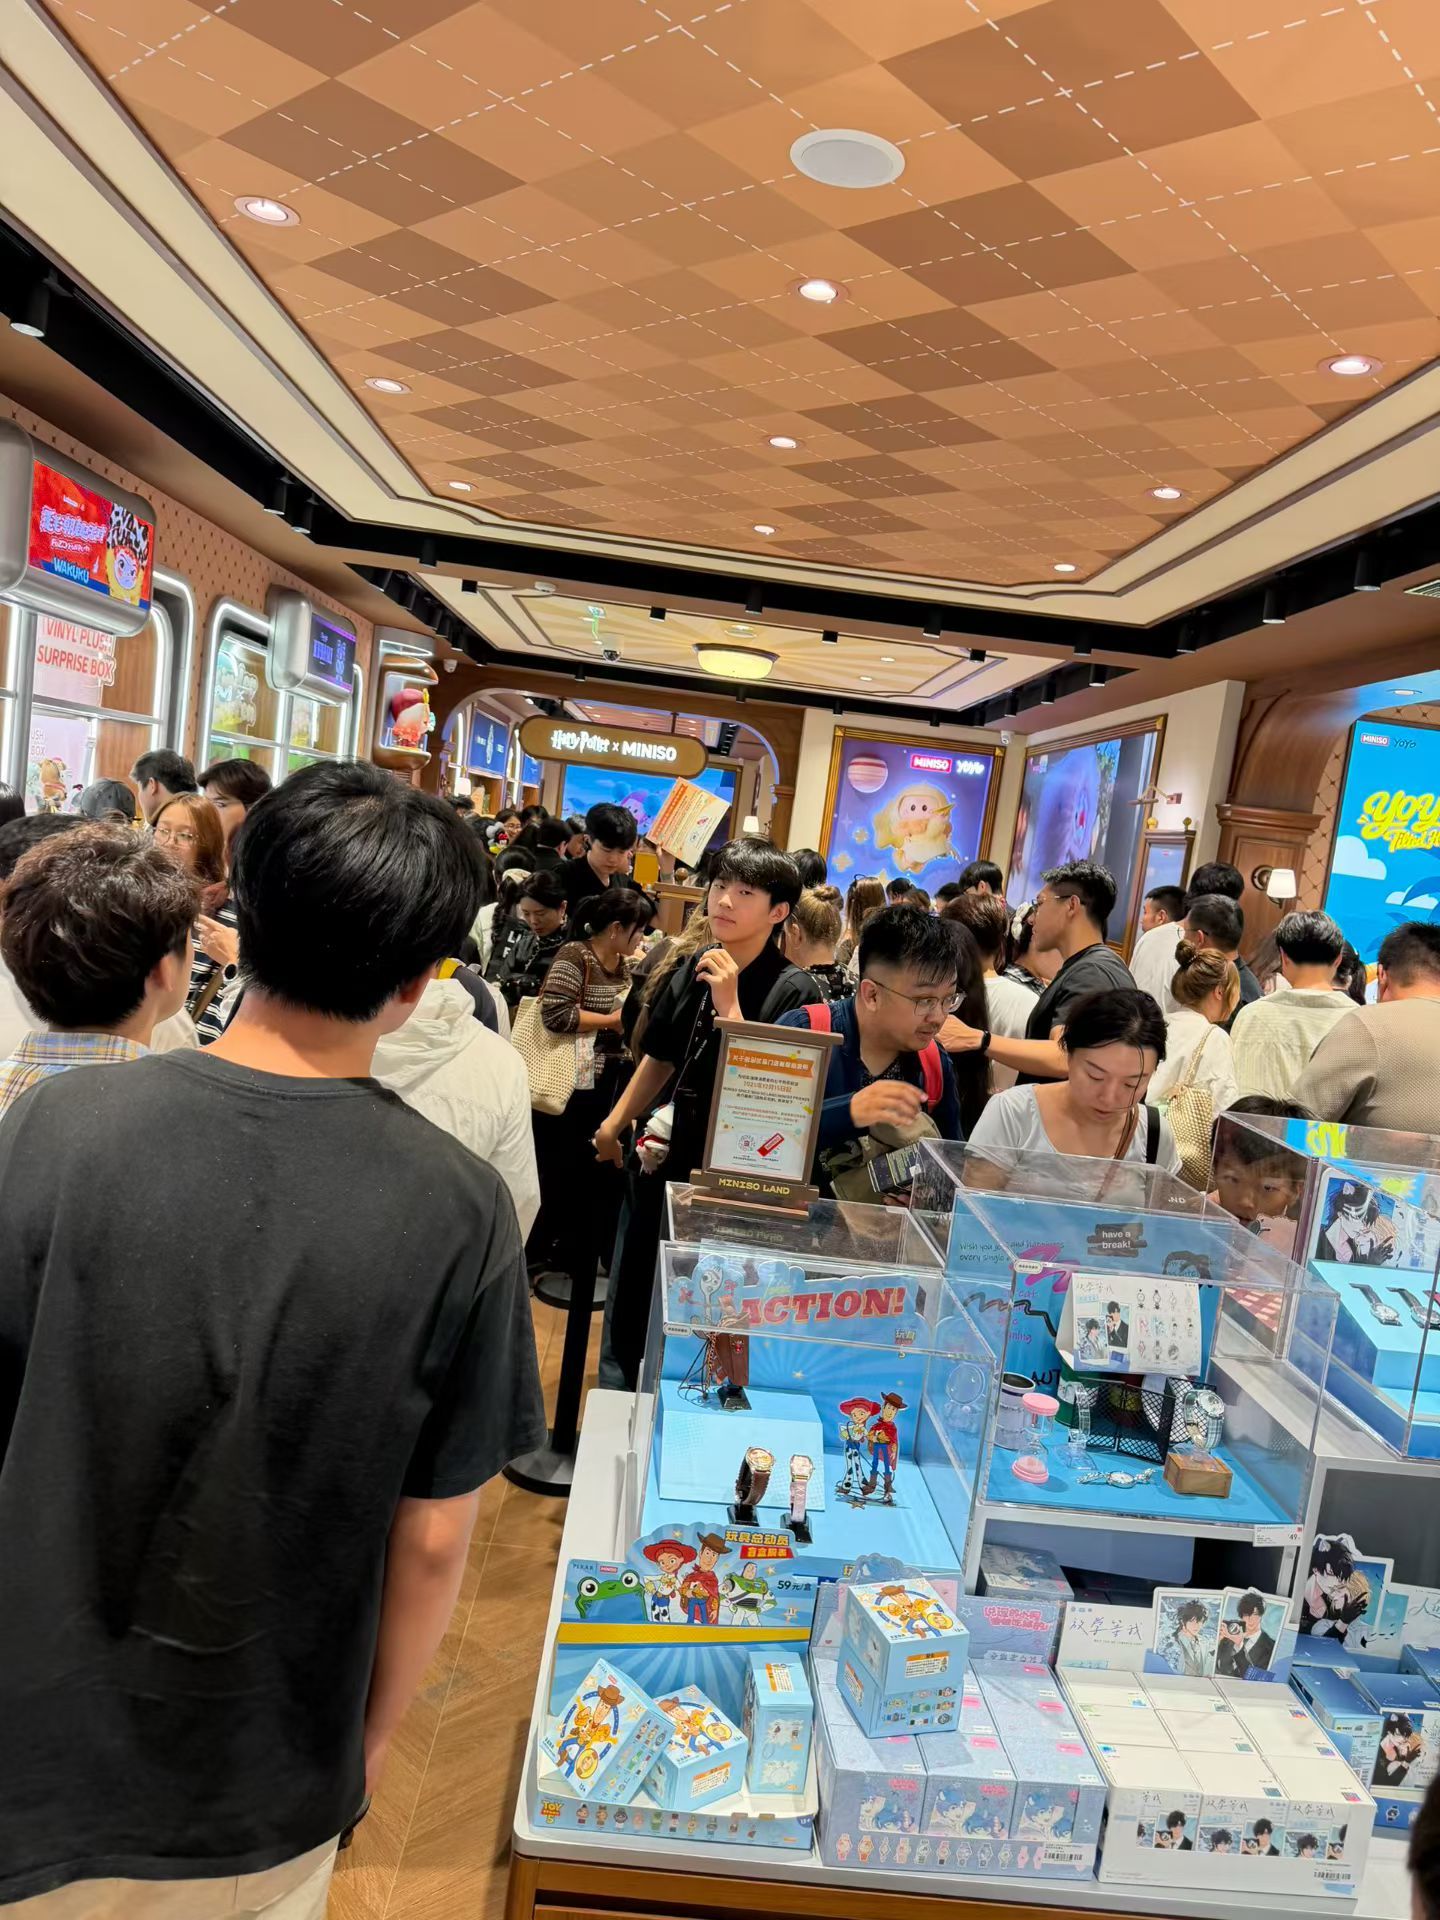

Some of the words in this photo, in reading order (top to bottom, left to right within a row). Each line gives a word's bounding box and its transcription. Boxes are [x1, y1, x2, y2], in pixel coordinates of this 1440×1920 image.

[53, 557, 90, 584] WAKUKU
[45, 618, 78, 643] VINYL
[37, 645, 87, 674] SURPRISE
[90, 659, 112, 679] BOX
[550, 729, 581, 751] Harry
[578, 730, 610, 753] Potter
[622, 741, 677, 762] MINISO
[1362, 734, 1388, 746] MINISO
[913, 756, 950, 770] MINISO
[718, 1178, 760, 1190] MINISO
[762, 1184, 790, 1195] LAND
[1102, 1230, 1123, 1239] have
[1102, 1241, 1131, 1249] break!
[960, 1253, 980, 1262] every
[741, 1287, 907, 1328] ACTION!
[725, 1529, 790, 1547] 玩具总动员
[1069, 1616, 1143, 1641] 放学等我
[543, 1802, 563, 1812] TOY
